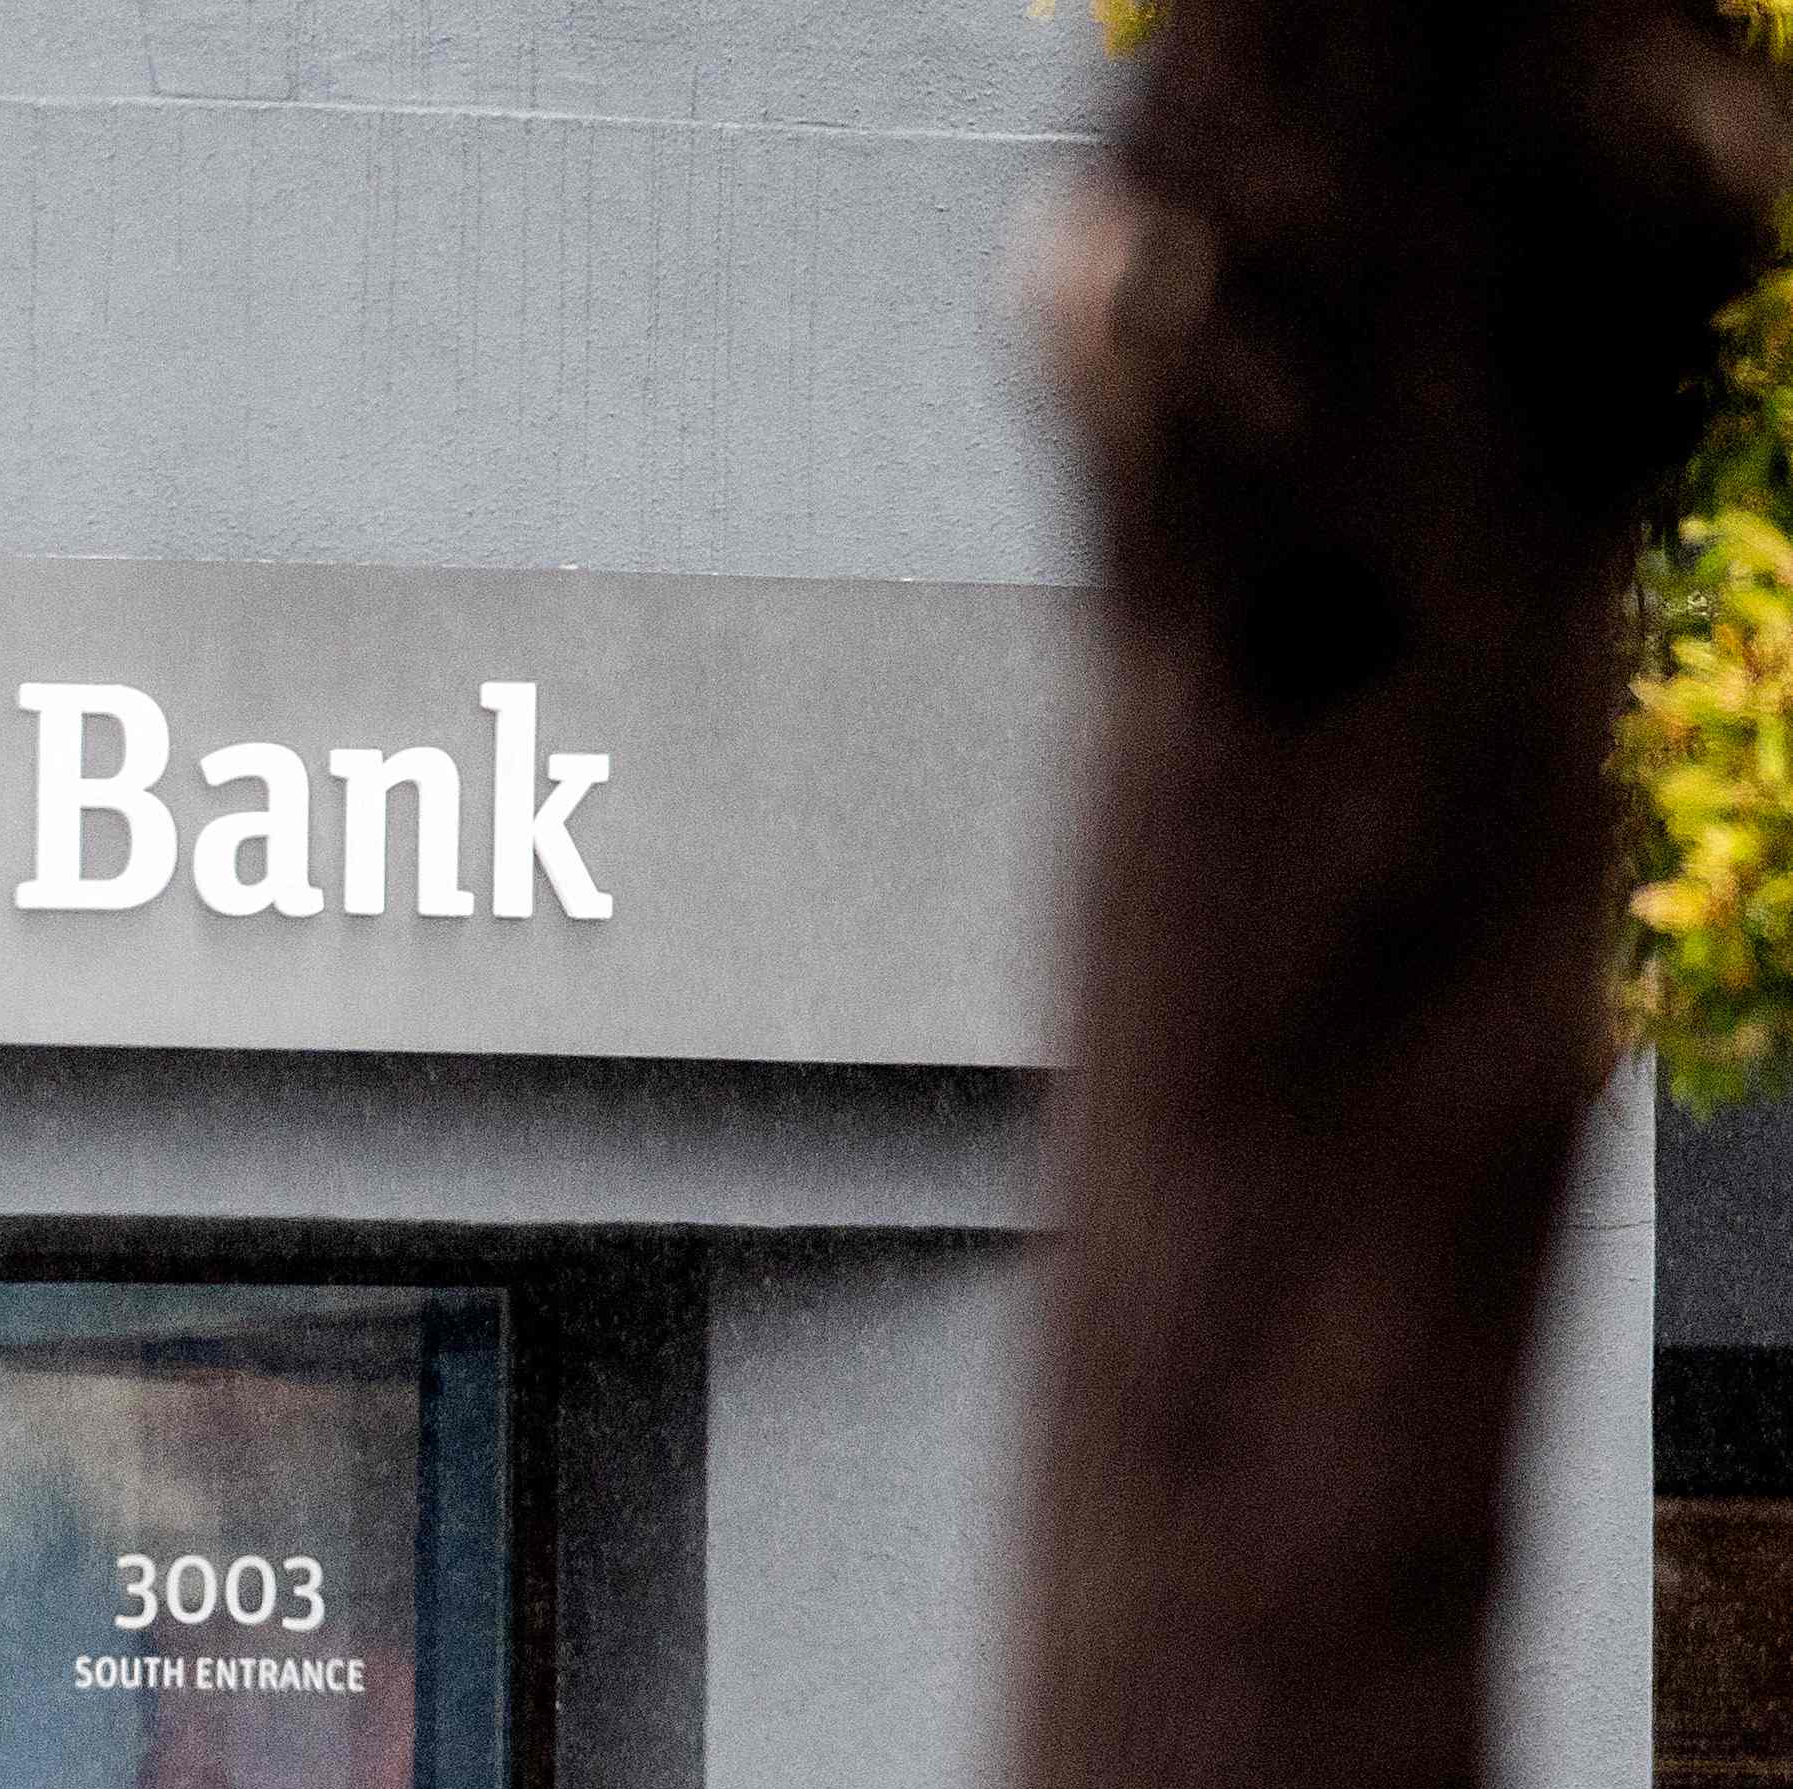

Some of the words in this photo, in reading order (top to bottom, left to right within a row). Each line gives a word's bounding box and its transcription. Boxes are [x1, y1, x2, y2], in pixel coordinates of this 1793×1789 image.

[14, 680, 616, 920] Bank
[114, 1553, 326, 1632] 3003
[74, 1655, 185, 1690] SOUTH
[196, 1656, 367, 1693] ENTRANCE
